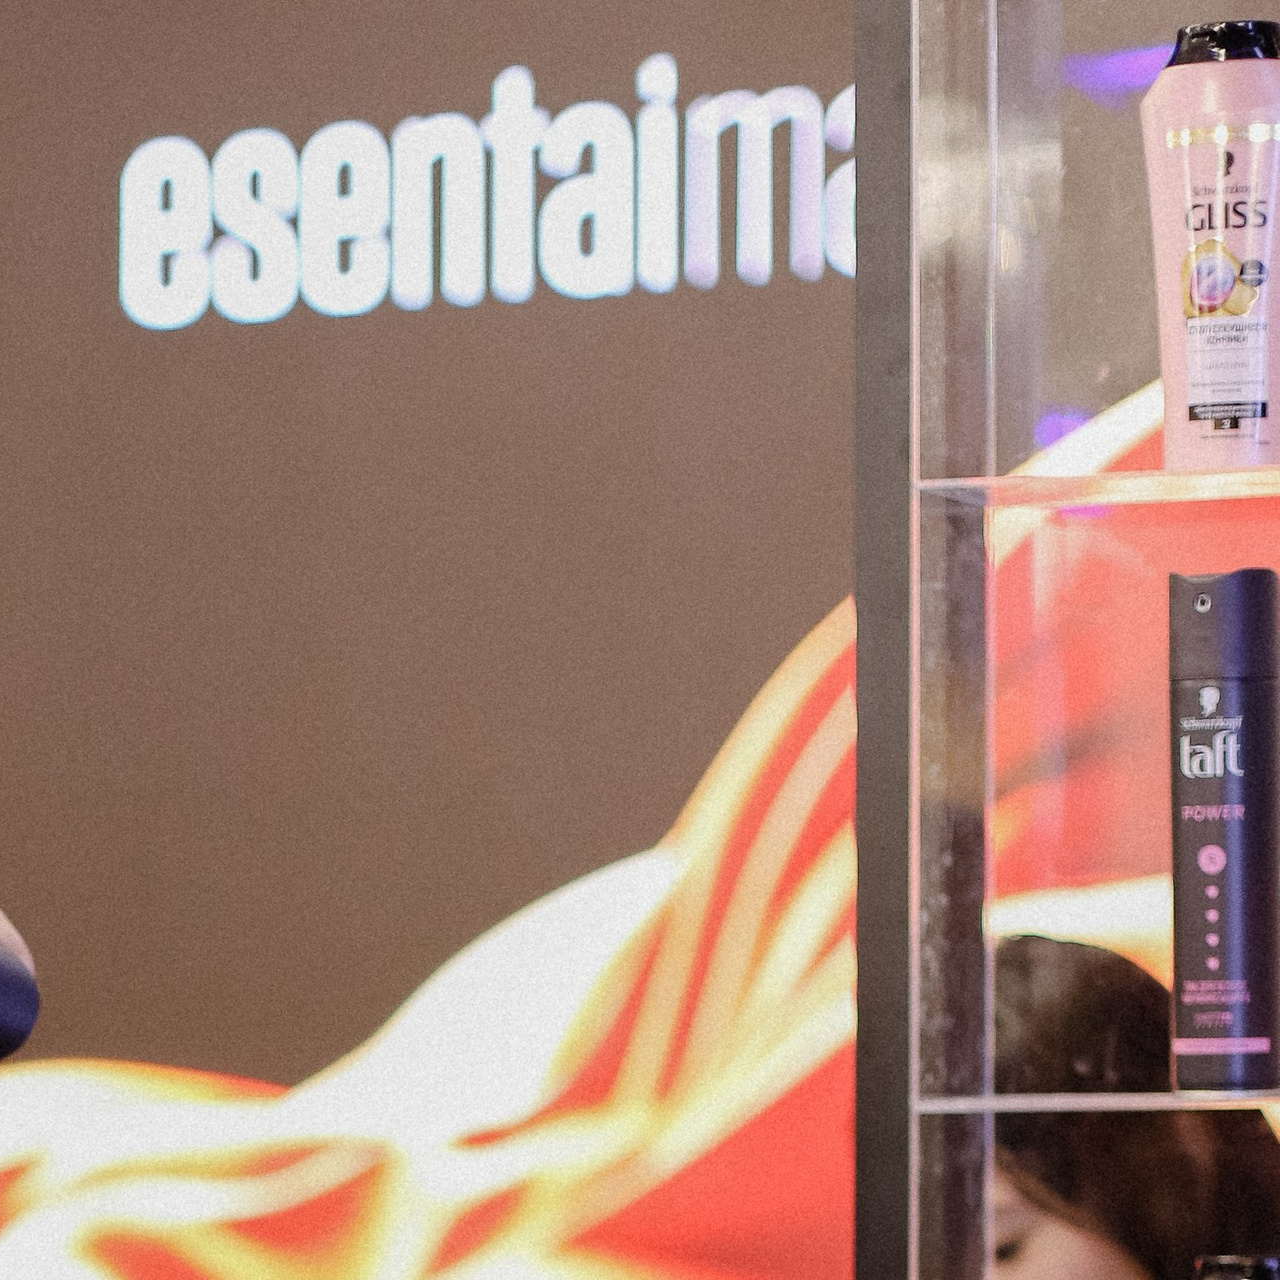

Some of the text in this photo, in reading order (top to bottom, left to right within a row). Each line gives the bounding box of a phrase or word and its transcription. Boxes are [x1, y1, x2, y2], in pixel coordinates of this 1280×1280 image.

[1185, 201, 1267, 231] GLISS
[1180, 729, 1245, 779] taft
[1181, 804, 1245, 821] POWER
